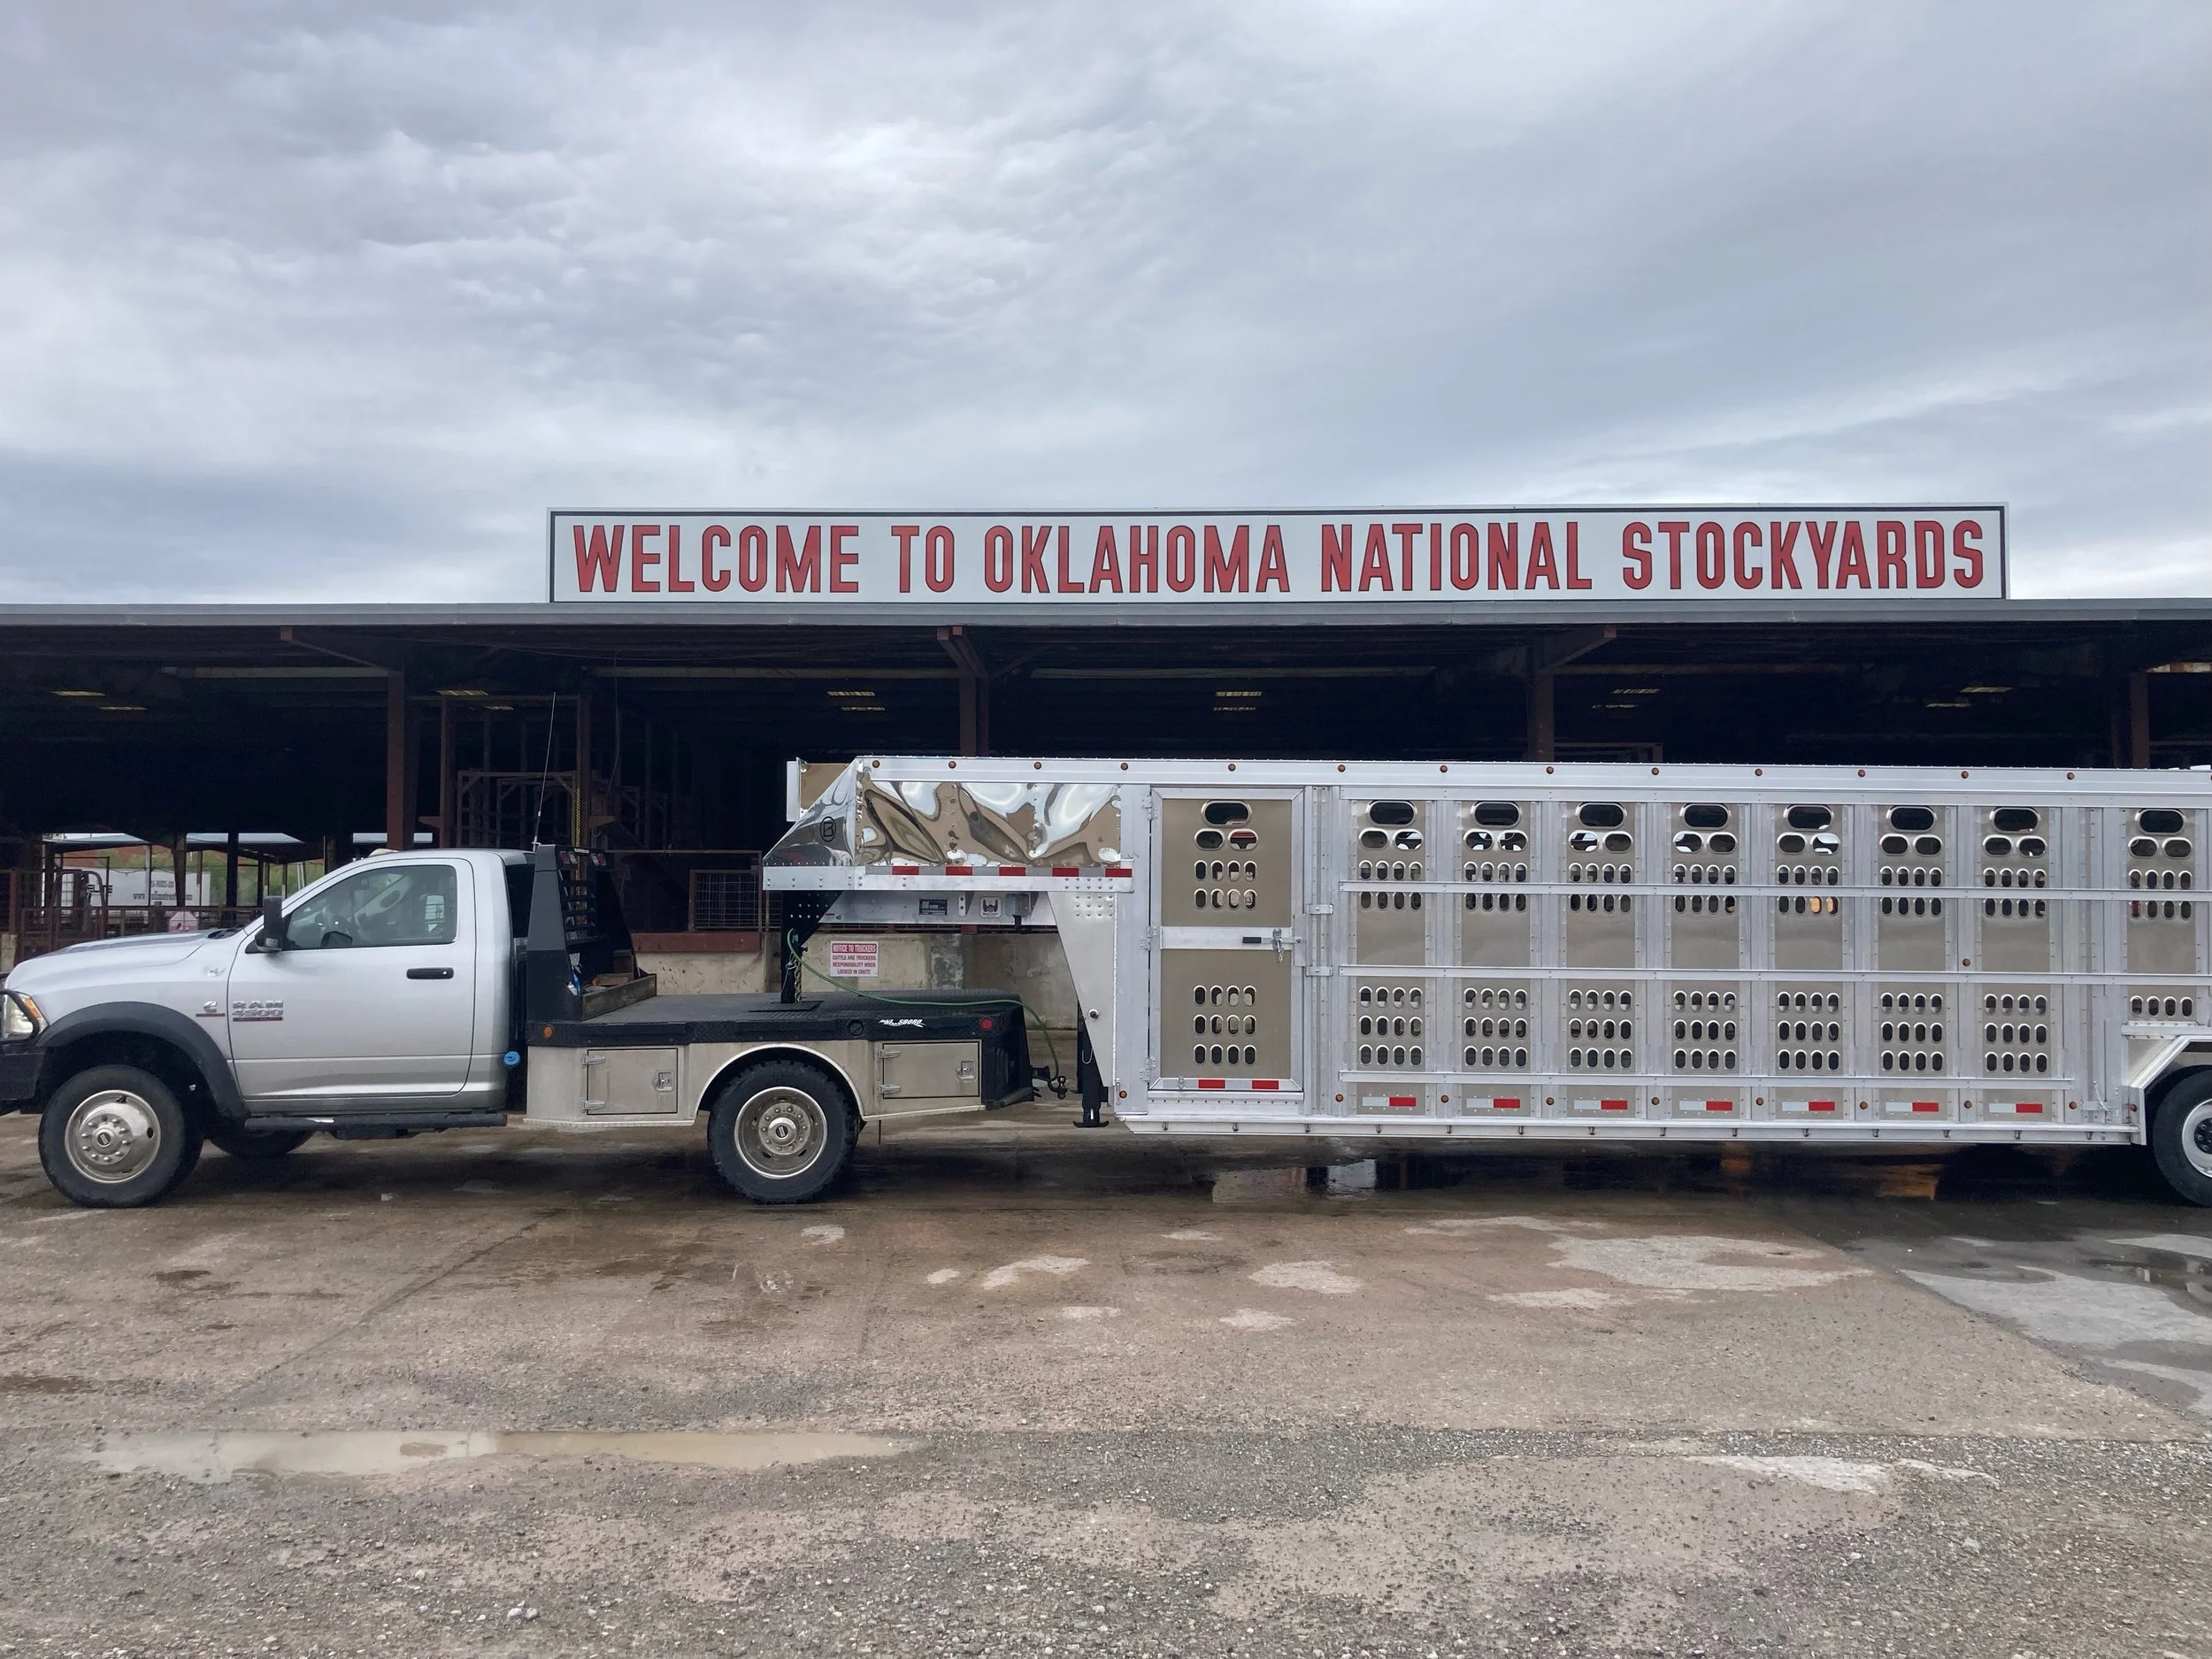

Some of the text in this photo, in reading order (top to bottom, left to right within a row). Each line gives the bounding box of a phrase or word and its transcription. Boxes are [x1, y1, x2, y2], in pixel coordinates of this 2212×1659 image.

[572, 520, 1984, 593] WELCOME TO OKLAHOMA NATIONAL STOCKYARDS
[855, 944, 876, 953] TRUCKERS
[233, 1000, 284, 1009] RAM
